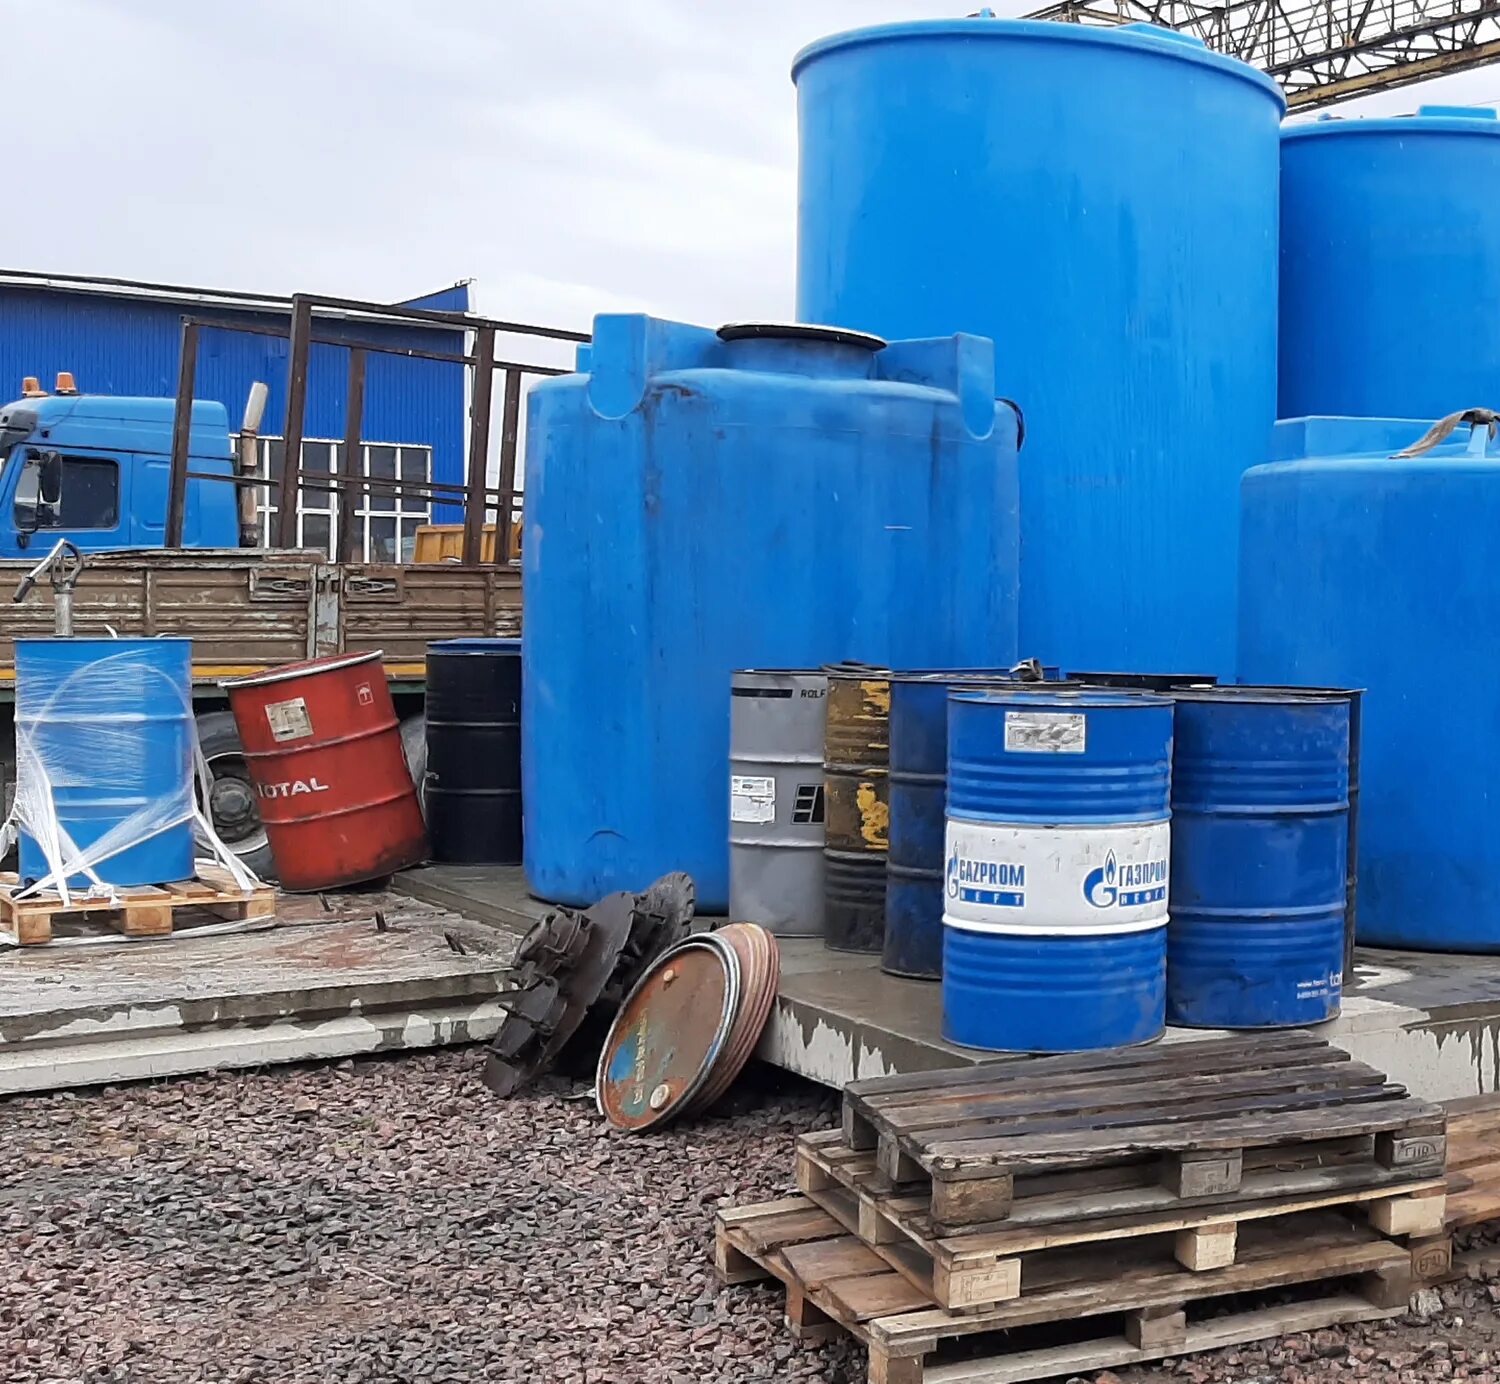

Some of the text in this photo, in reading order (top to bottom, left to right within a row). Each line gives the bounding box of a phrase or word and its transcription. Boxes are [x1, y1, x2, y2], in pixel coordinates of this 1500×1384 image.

[800, 689, 826, 699] ROLF
[959, 859, 1025, 887] GAZPROM
[1118, 858, 1167, 887] ГАЗПРОМ
